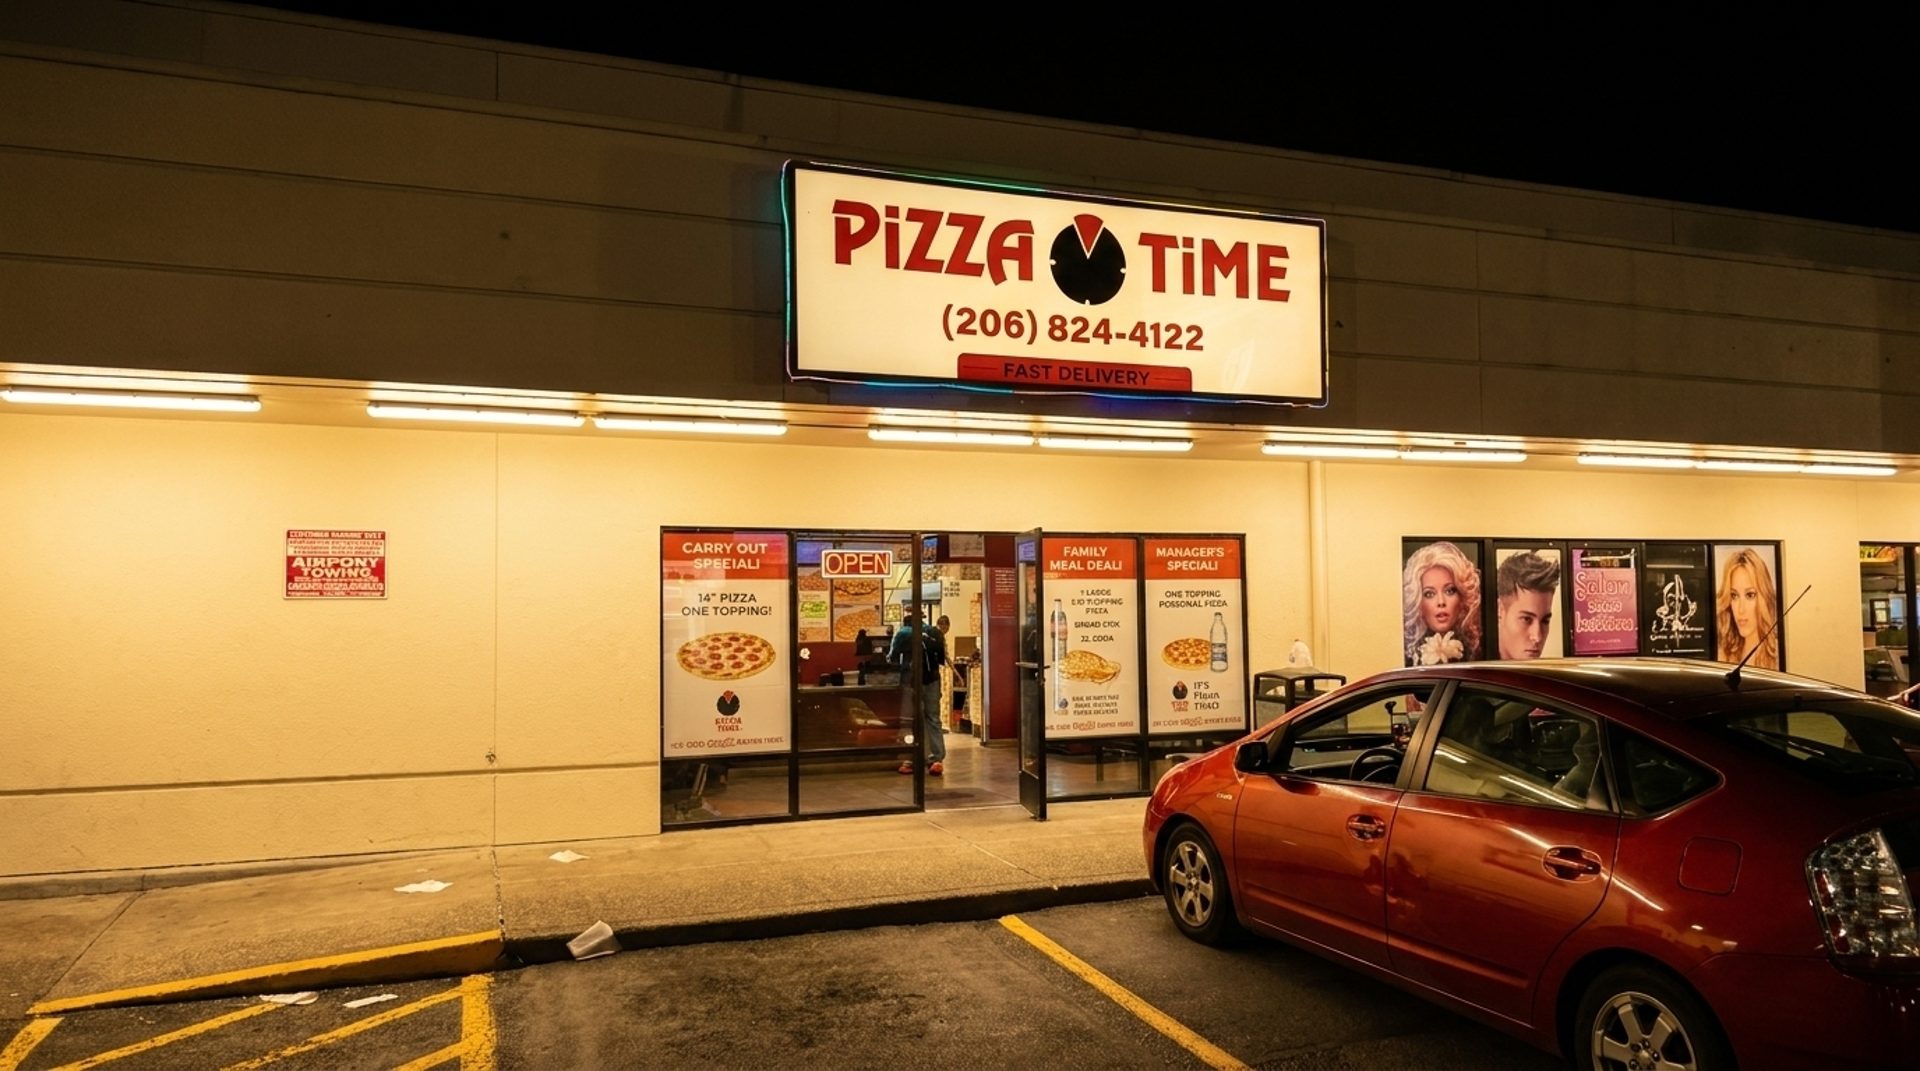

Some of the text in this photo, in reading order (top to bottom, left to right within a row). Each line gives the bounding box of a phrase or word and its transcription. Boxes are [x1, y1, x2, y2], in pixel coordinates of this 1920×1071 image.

[942, 303, 1204, 351] (206) 824-4122
[1004, 362, 1151, 386] FAST DELIVERY
[682, 542, 769, 555] CARRY OUT
[1063, 546, 1108, 557] FAMILY
[1156, 547, 1225, 558] MANAGER'S
[825, 552, 890, 575] OPEN
[1050, 560, 1085, 571] MEAL
[301, 567, 372, 577] TOWING
[719, 593, 758, 603] PIZZA
[1185, 590, 1222, 599] TOPPING
[681, 606, 773, 616] ONE TOPPING!
